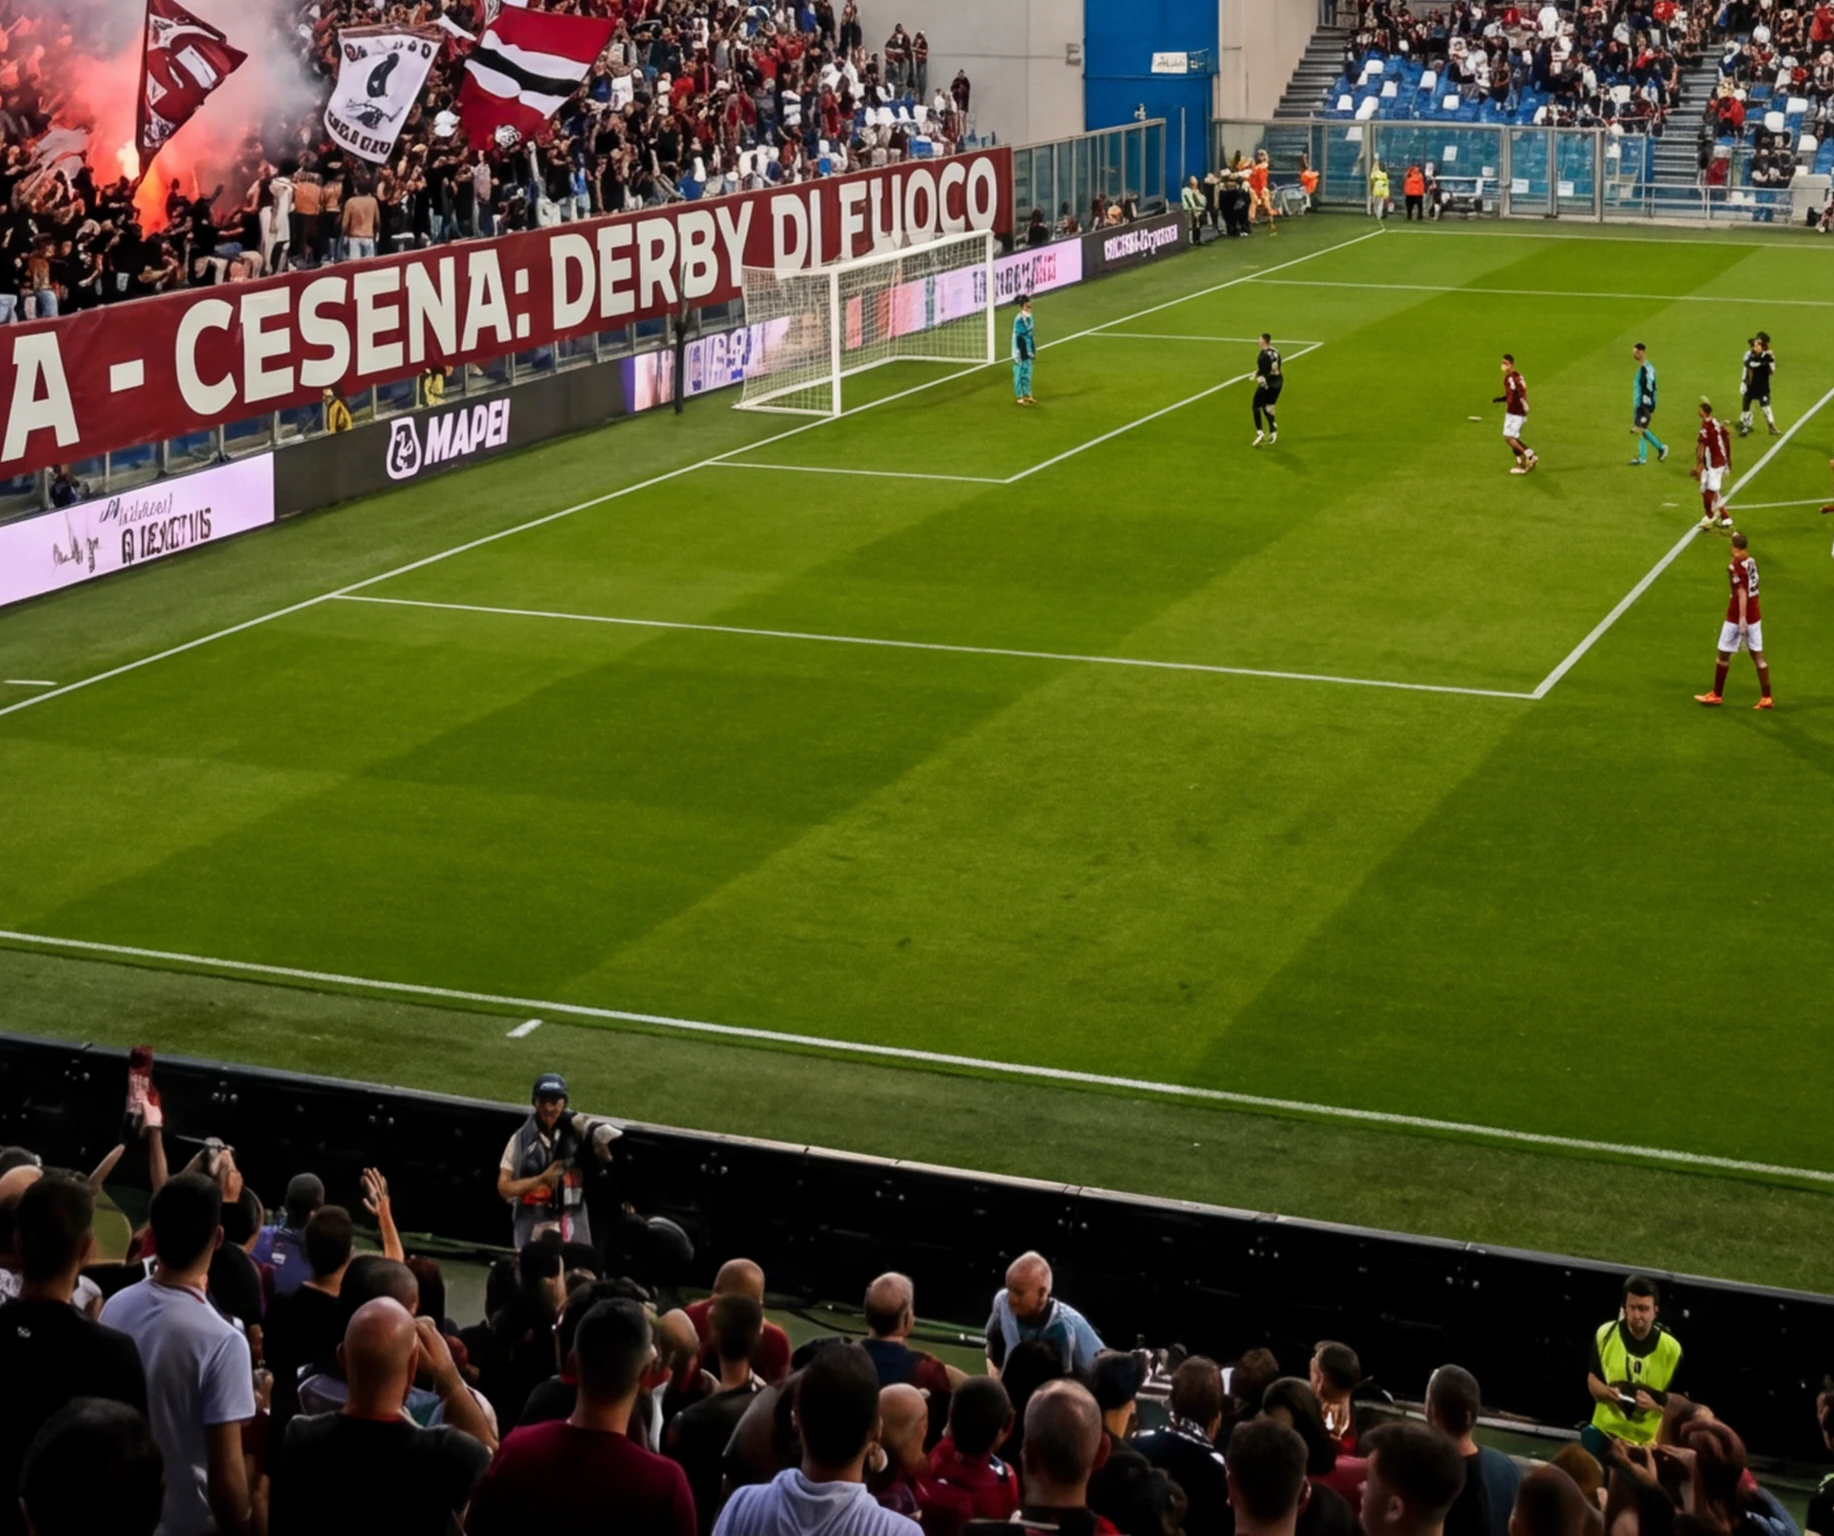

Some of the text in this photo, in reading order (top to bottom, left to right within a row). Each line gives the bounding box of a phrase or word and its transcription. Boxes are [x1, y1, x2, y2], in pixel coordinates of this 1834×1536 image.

[174, 247, 530, 415] CESENA:
[550, 201, 754, 329] DERBY
[771, 189, 823, 279] DI
[838, 156, 999, 256] FUOCO
[425, 398, 511, 466] MAPEI
